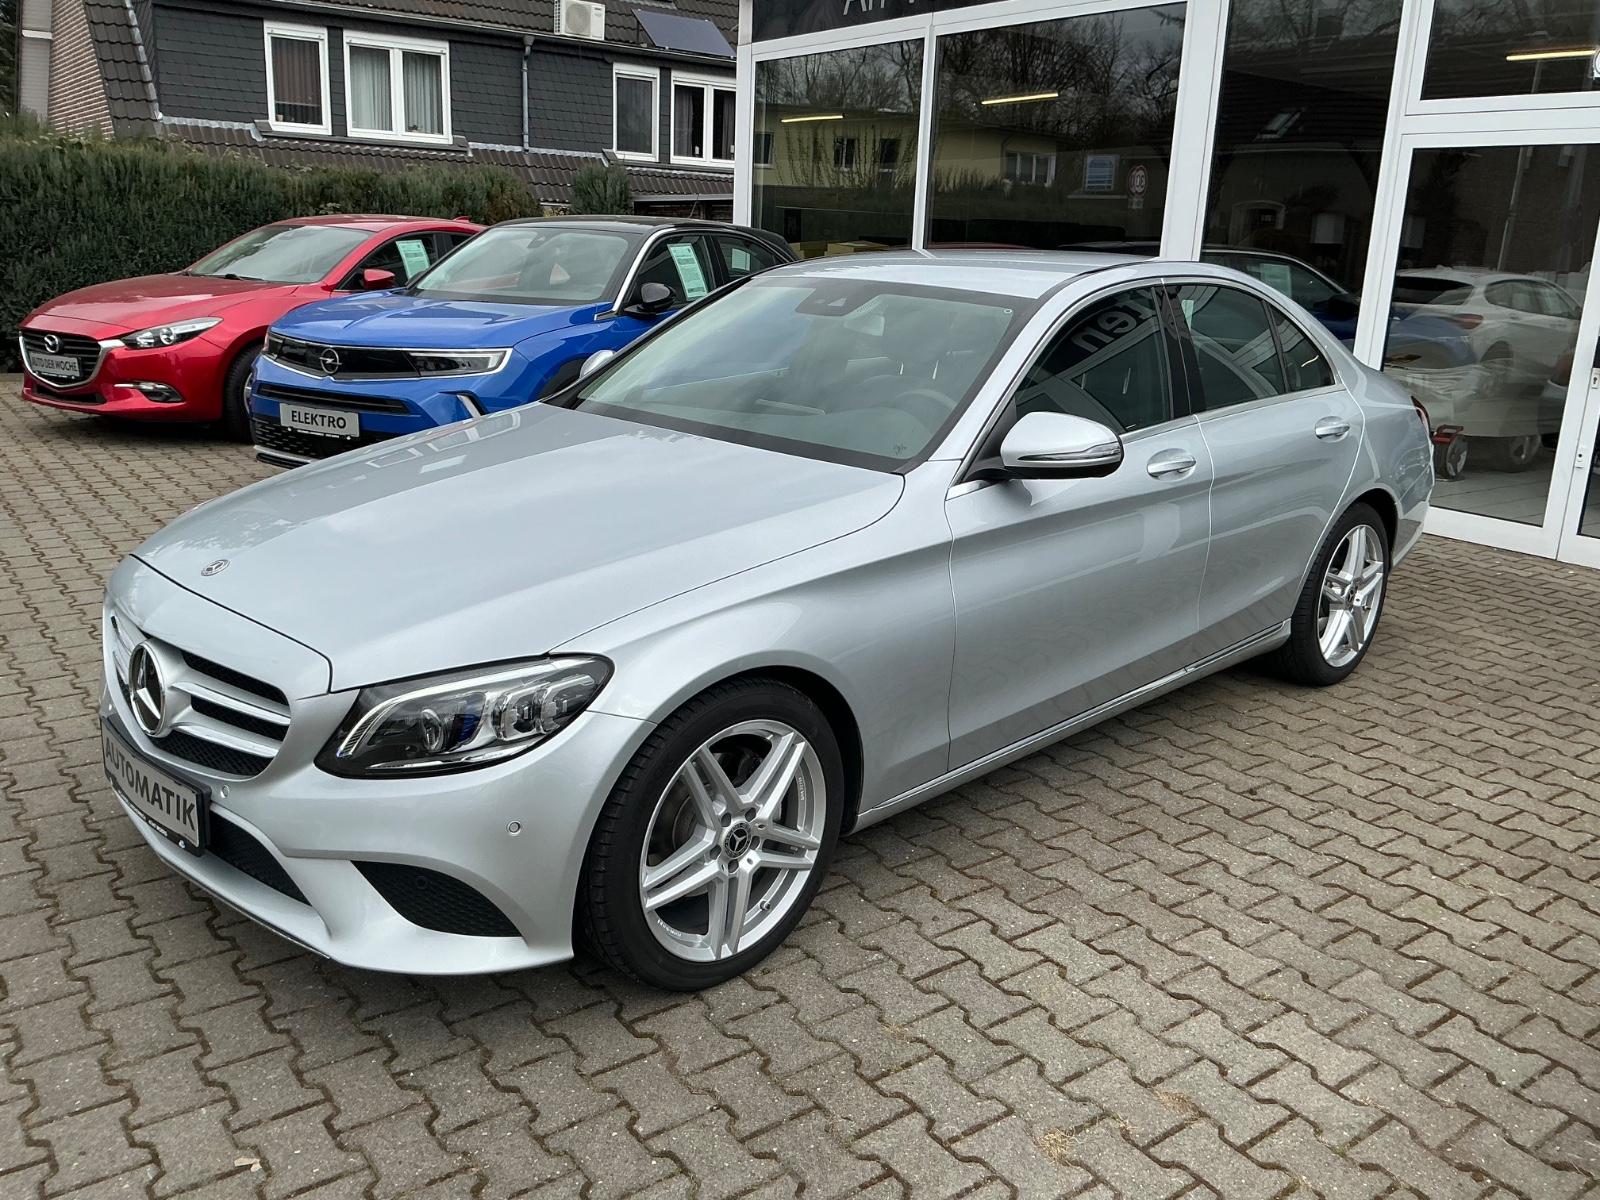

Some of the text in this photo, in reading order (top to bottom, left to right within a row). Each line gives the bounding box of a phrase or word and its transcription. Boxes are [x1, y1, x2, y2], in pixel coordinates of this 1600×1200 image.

[44, 358, 55, 370] DER
[55, 360, 78, 372] WOCHE
[291, 410, 347, 429] ELEKTRO
[105, 737, 196, 832] AUTOMATIK
